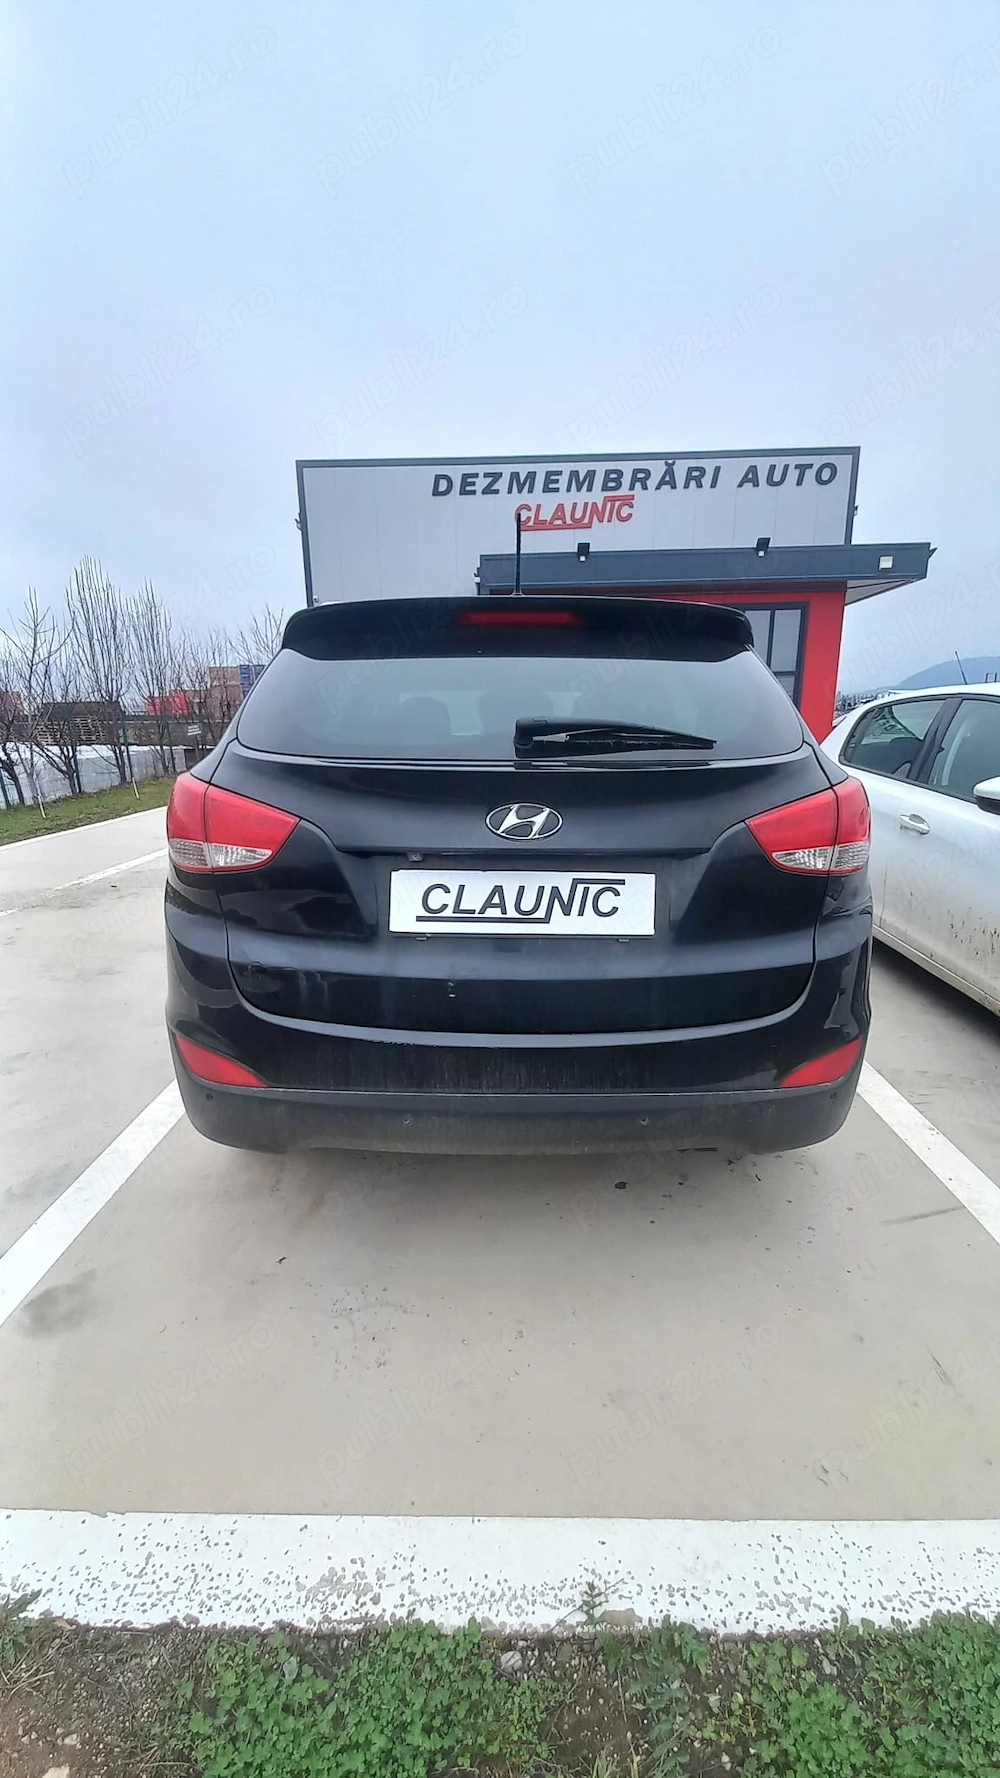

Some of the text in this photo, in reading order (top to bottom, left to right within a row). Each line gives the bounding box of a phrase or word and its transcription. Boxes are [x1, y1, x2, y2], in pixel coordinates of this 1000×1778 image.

[432, 461, 838, 497] DEZMEMBRĂRI AUTO
[515, 494, 635, 532] CLAUNIC
[416, 878, 626, 924] CLAUNIC
